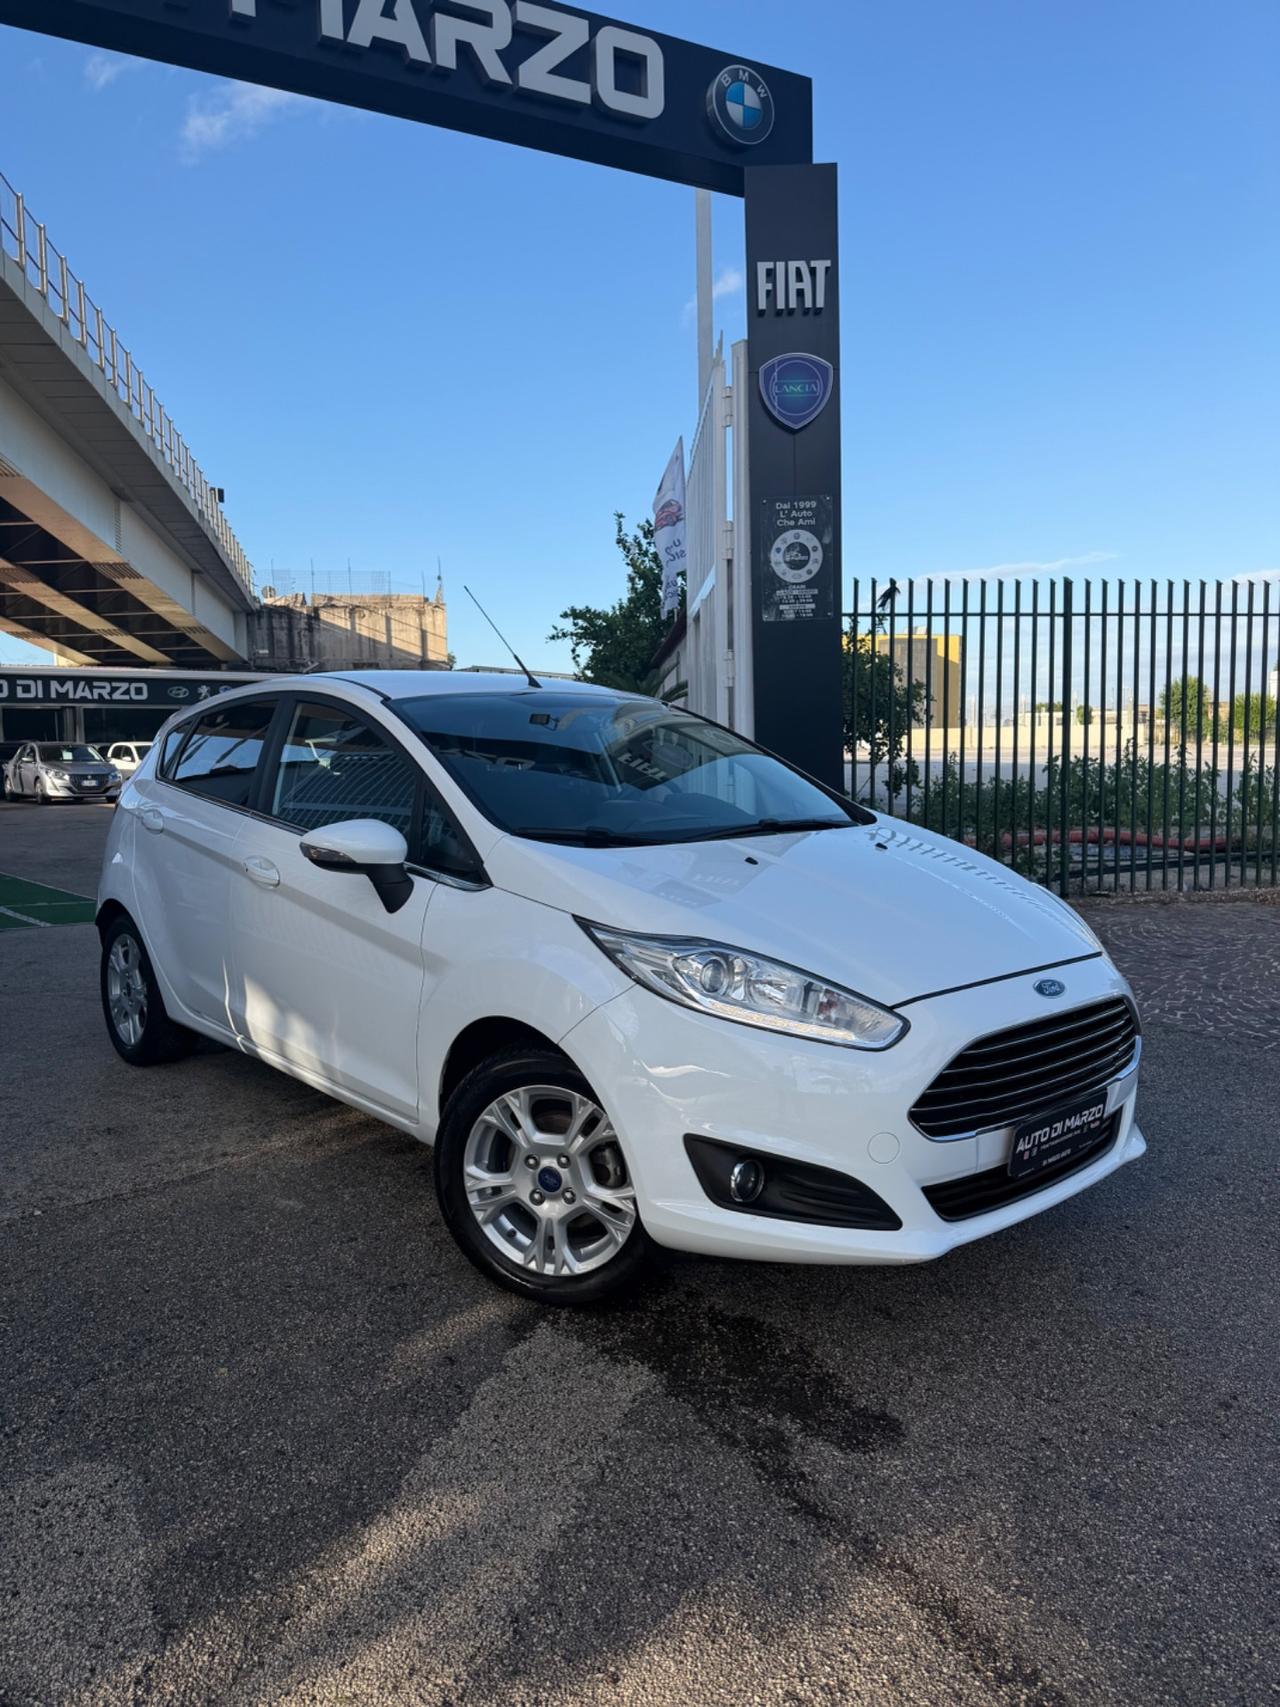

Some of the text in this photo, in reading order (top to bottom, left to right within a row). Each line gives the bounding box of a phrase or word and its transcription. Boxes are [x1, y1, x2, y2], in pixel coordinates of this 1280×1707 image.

[721, 69, 767, 98] BMW
[757, 259, 831, 310] FIAT
[774, 382, 817, 394] LANCIA
[793, 501, 816, 509] 1999
[16, 679, 43, 698] DI
[50, 680, 148, 700] MARZO
[1016, 1127, 1050, 1154] AUTO
[1051, 1121, 1063, 1138] DI
[1063, 1104, 1104, 1132] MARZO
